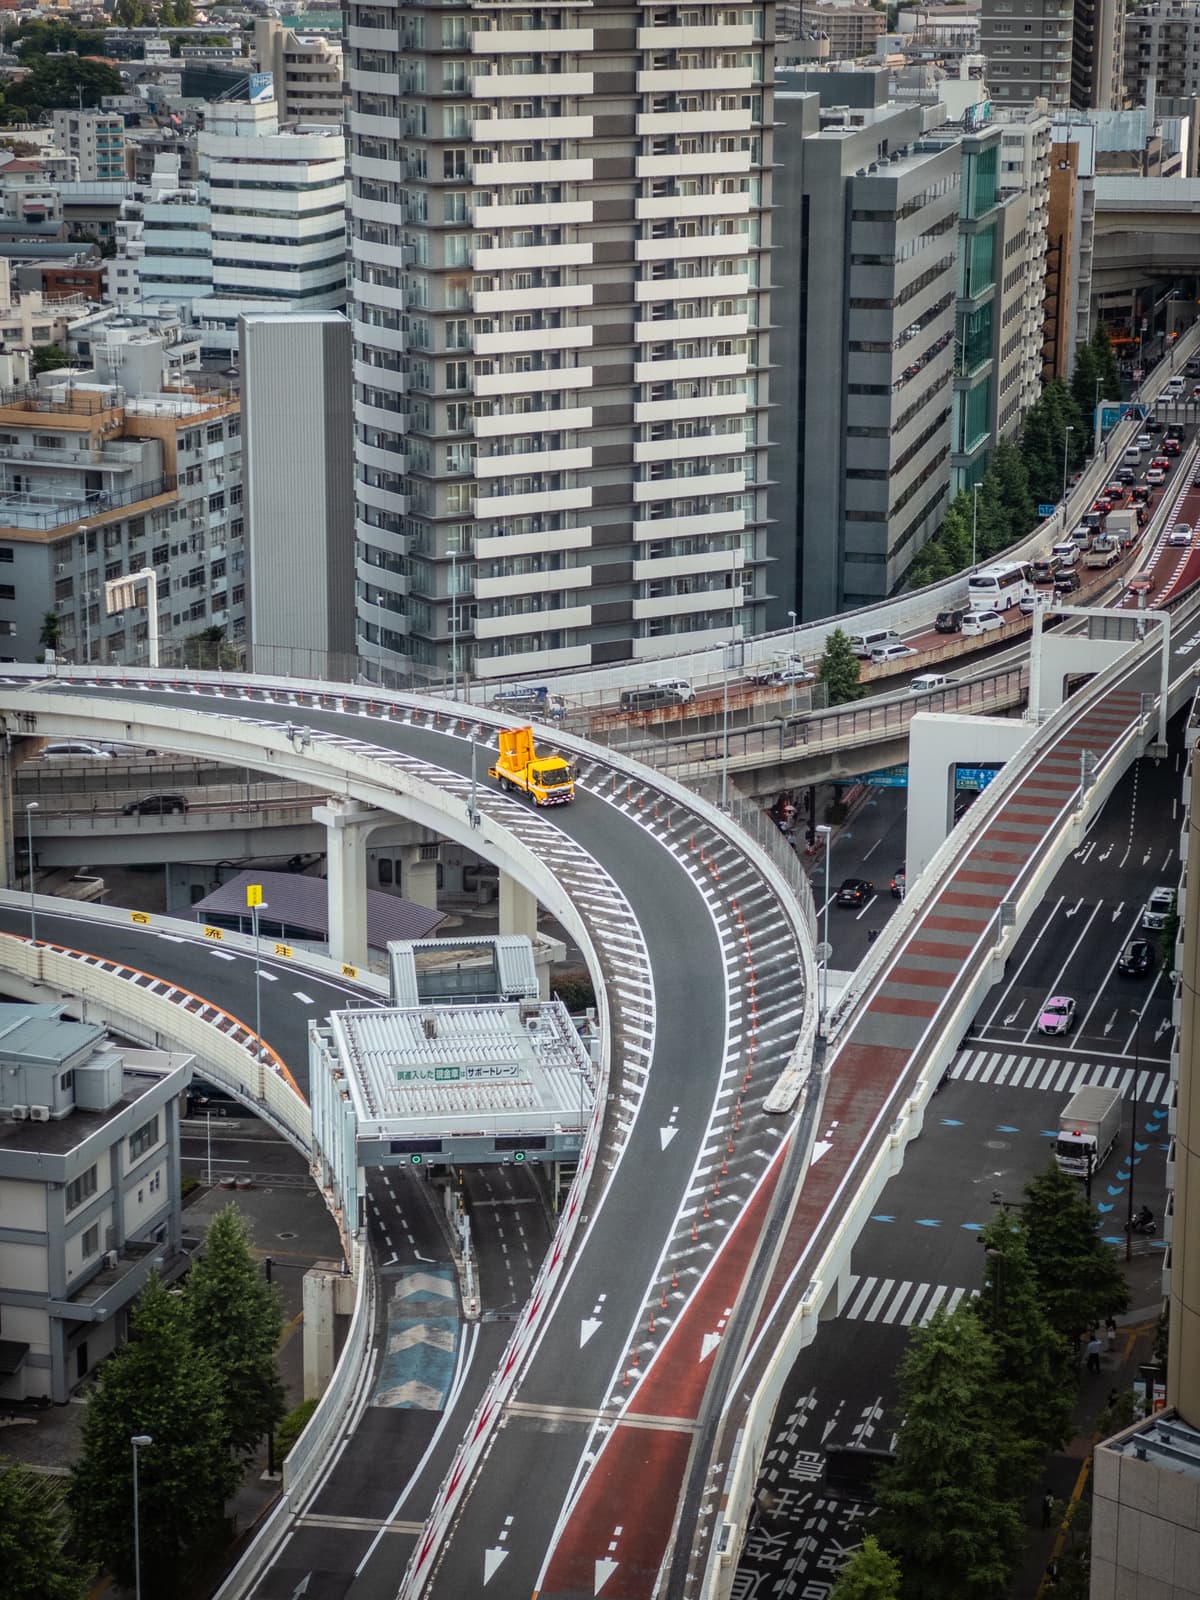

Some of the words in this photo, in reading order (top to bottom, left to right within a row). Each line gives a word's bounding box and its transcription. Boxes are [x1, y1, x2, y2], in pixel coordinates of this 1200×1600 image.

[467, 1066, 517, 1078] サポートレーン
